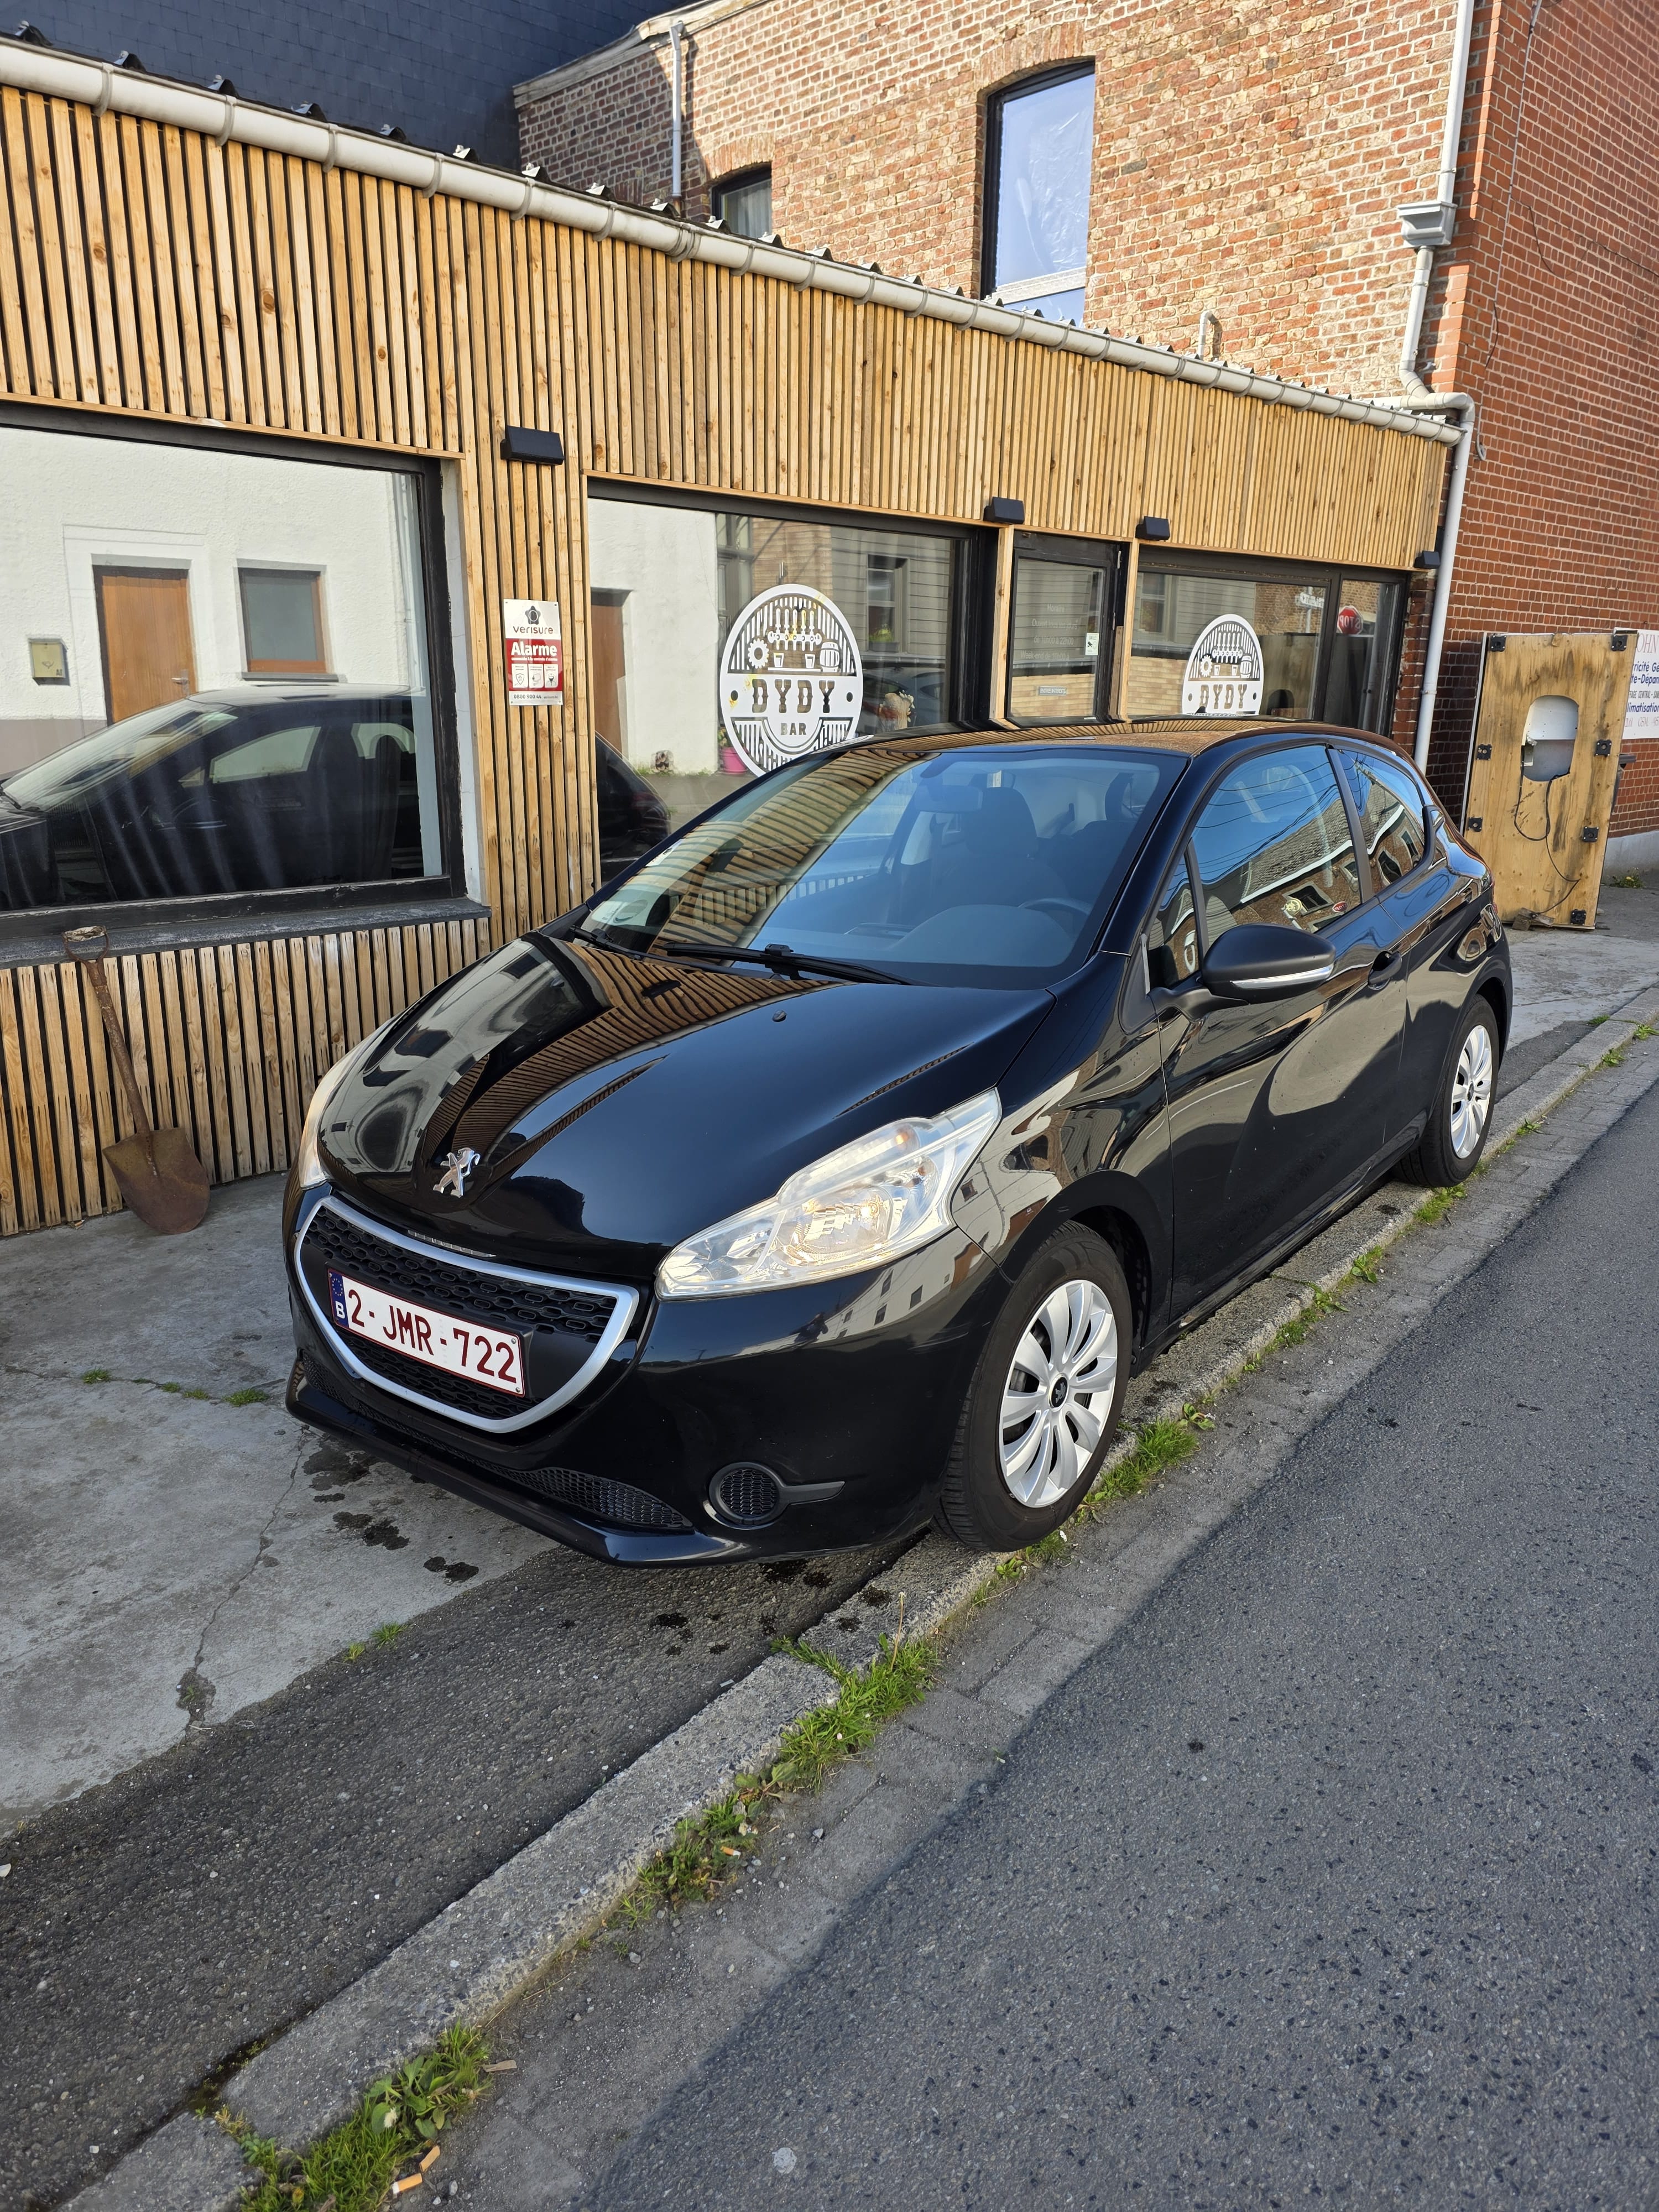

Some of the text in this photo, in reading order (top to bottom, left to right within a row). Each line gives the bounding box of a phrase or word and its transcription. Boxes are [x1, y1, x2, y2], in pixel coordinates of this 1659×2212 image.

[513, 626, 554, 634] verisure
[511, 641, 557, 656] Alarme
[1634, 660, 1650, 672] ricité
[752, 679, 835, 713] DYDY
[1199, 684, 1248, 709] DYDY
[781, 722, 807, 735] BAR
[335, 1301, 346, 1319] B
[348, 1289, 517, 1384] 2-JMR-722
